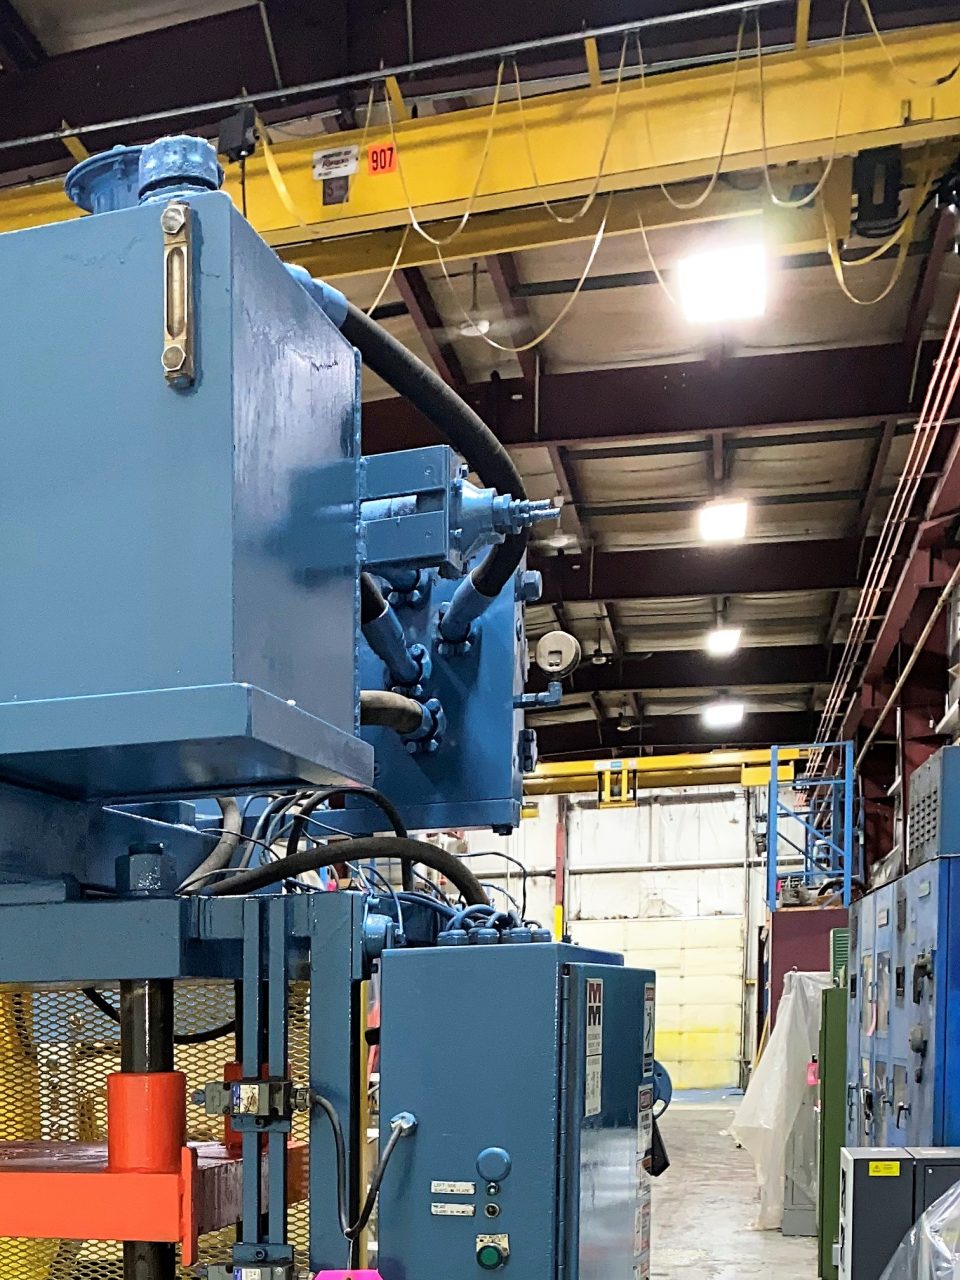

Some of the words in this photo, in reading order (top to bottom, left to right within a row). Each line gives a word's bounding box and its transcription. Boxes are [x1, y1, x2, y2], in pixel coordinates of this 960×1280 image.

[371, 146, 394, 171] 907
[588, 982, 602, 1004] M
[588, 1005, 601, 1027] M
